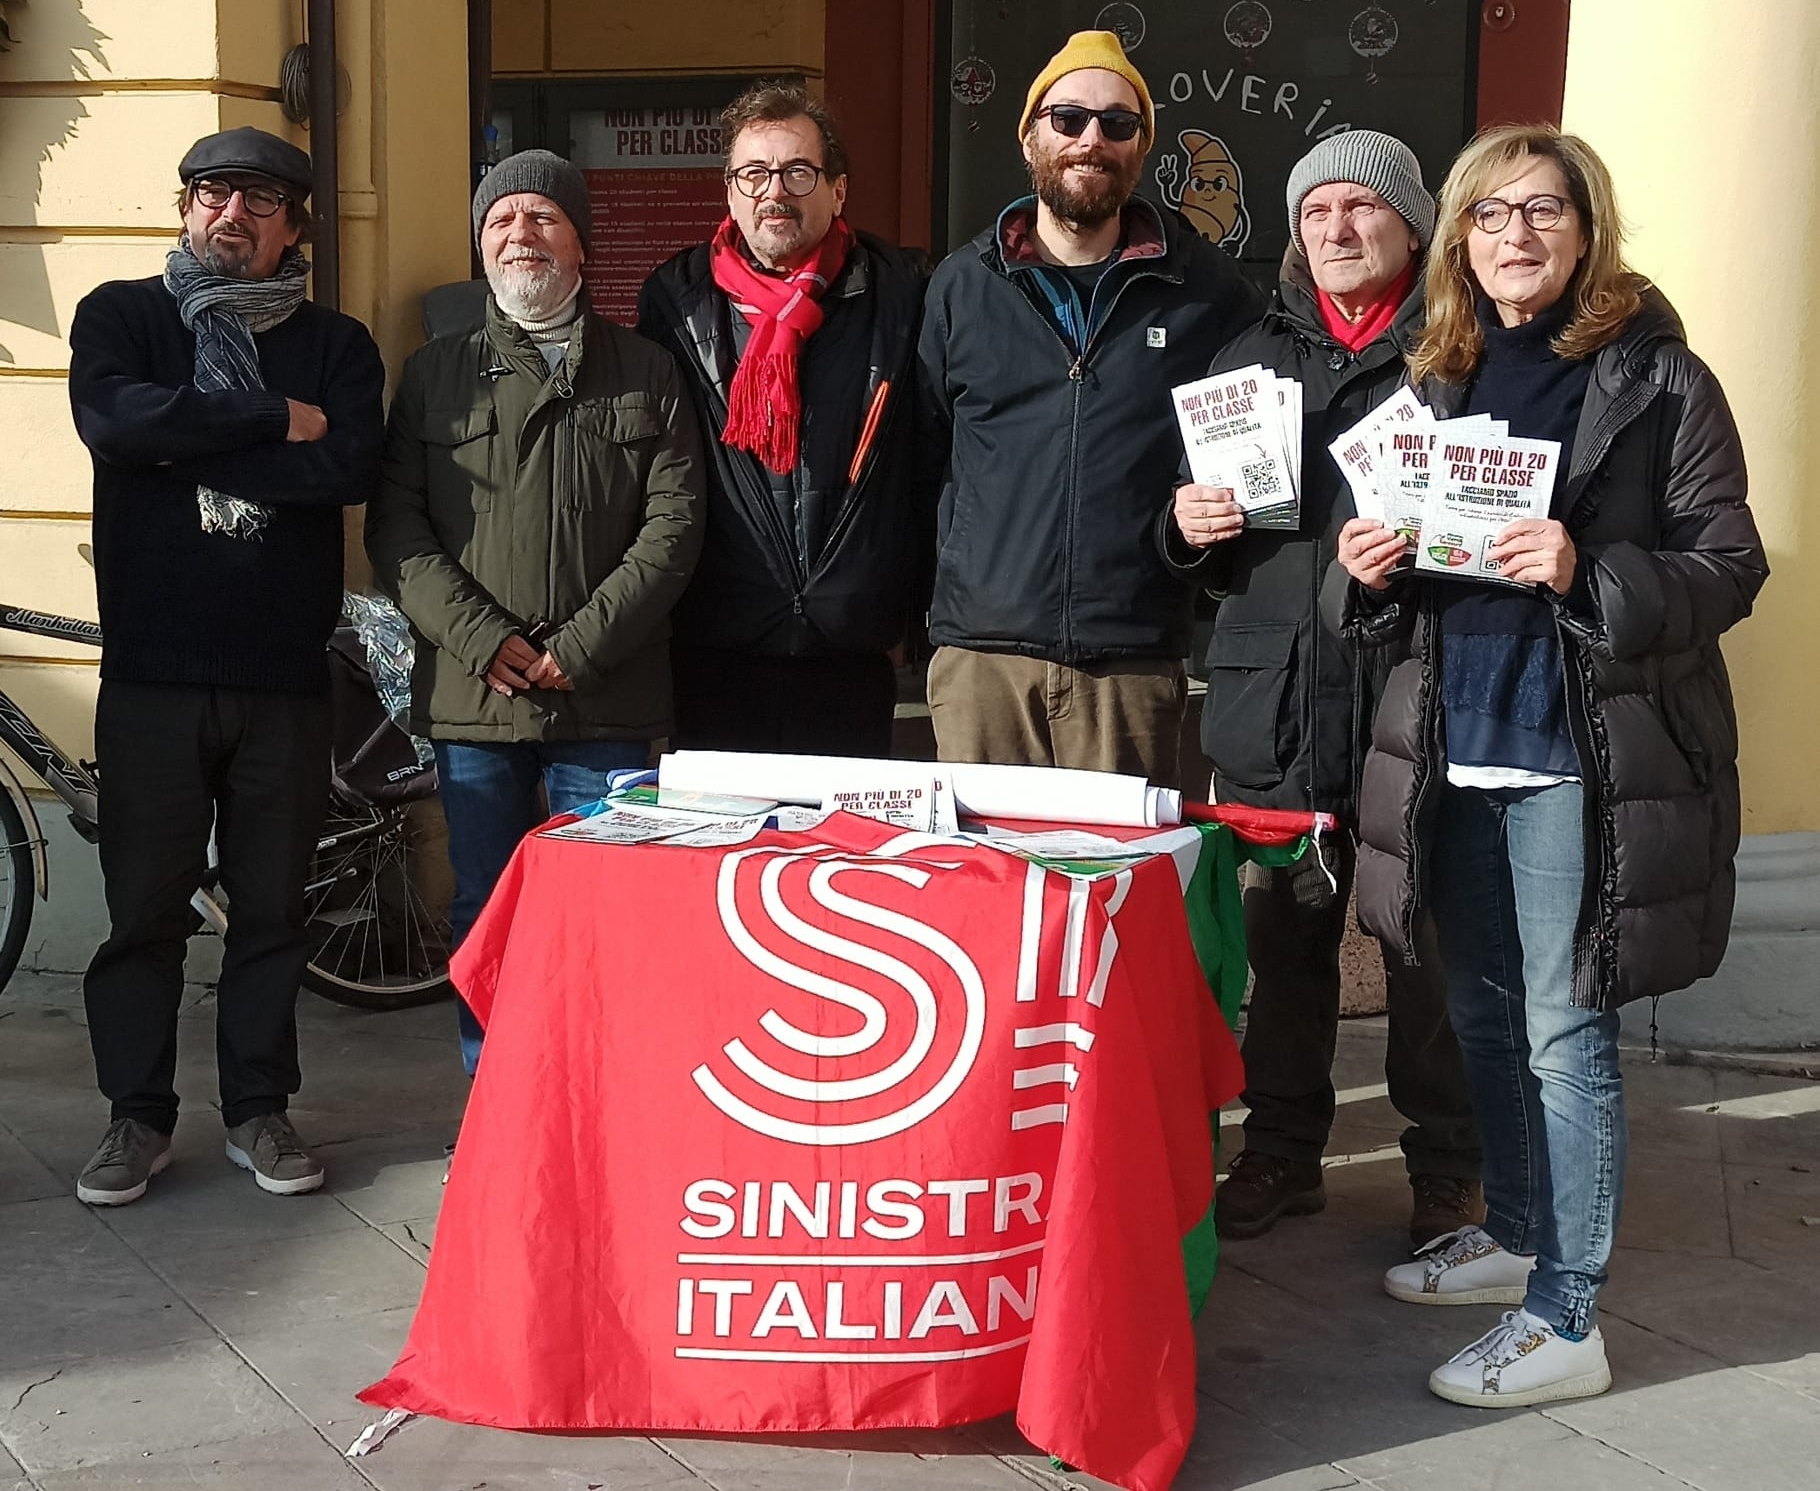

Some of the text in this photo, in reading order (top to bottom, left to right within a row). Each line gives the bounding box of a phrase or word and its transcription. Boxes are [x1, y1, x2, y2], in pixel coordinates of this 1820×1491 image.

[1155, 68, 1350, 139] OVERi
[604, 107, 645, 127] NON
[692, 107, 711, 126] DI
[616, 129, 723, 155] PER CLASS
[627, 173, 667, 181] CHIAVE
[669, 172, 703, 181] DELLA
[1181, 394, 1202, 413] NON
[1225, 384, 1239, 400] DI
[1241, 379, 1258, 396] 20
[1190, 396, 1255, 427] PER CLASSE
[1342, 439, 1368, 466] NON
[1393, 434, 1424, 451] NON
[1402, 452, 1428, 469] PER
[1443, 444, 1547, 470] NON PIÙ DI 20
[1450, 463, 1535, 487] PER CLASSE
[387, 761, 425, 782] BRN
[833, 788, 922, 802] NON PIÙ DI 20
[841, 801, 863, 811] PER
[679, 1171, 1048, 1241] SINISTR
